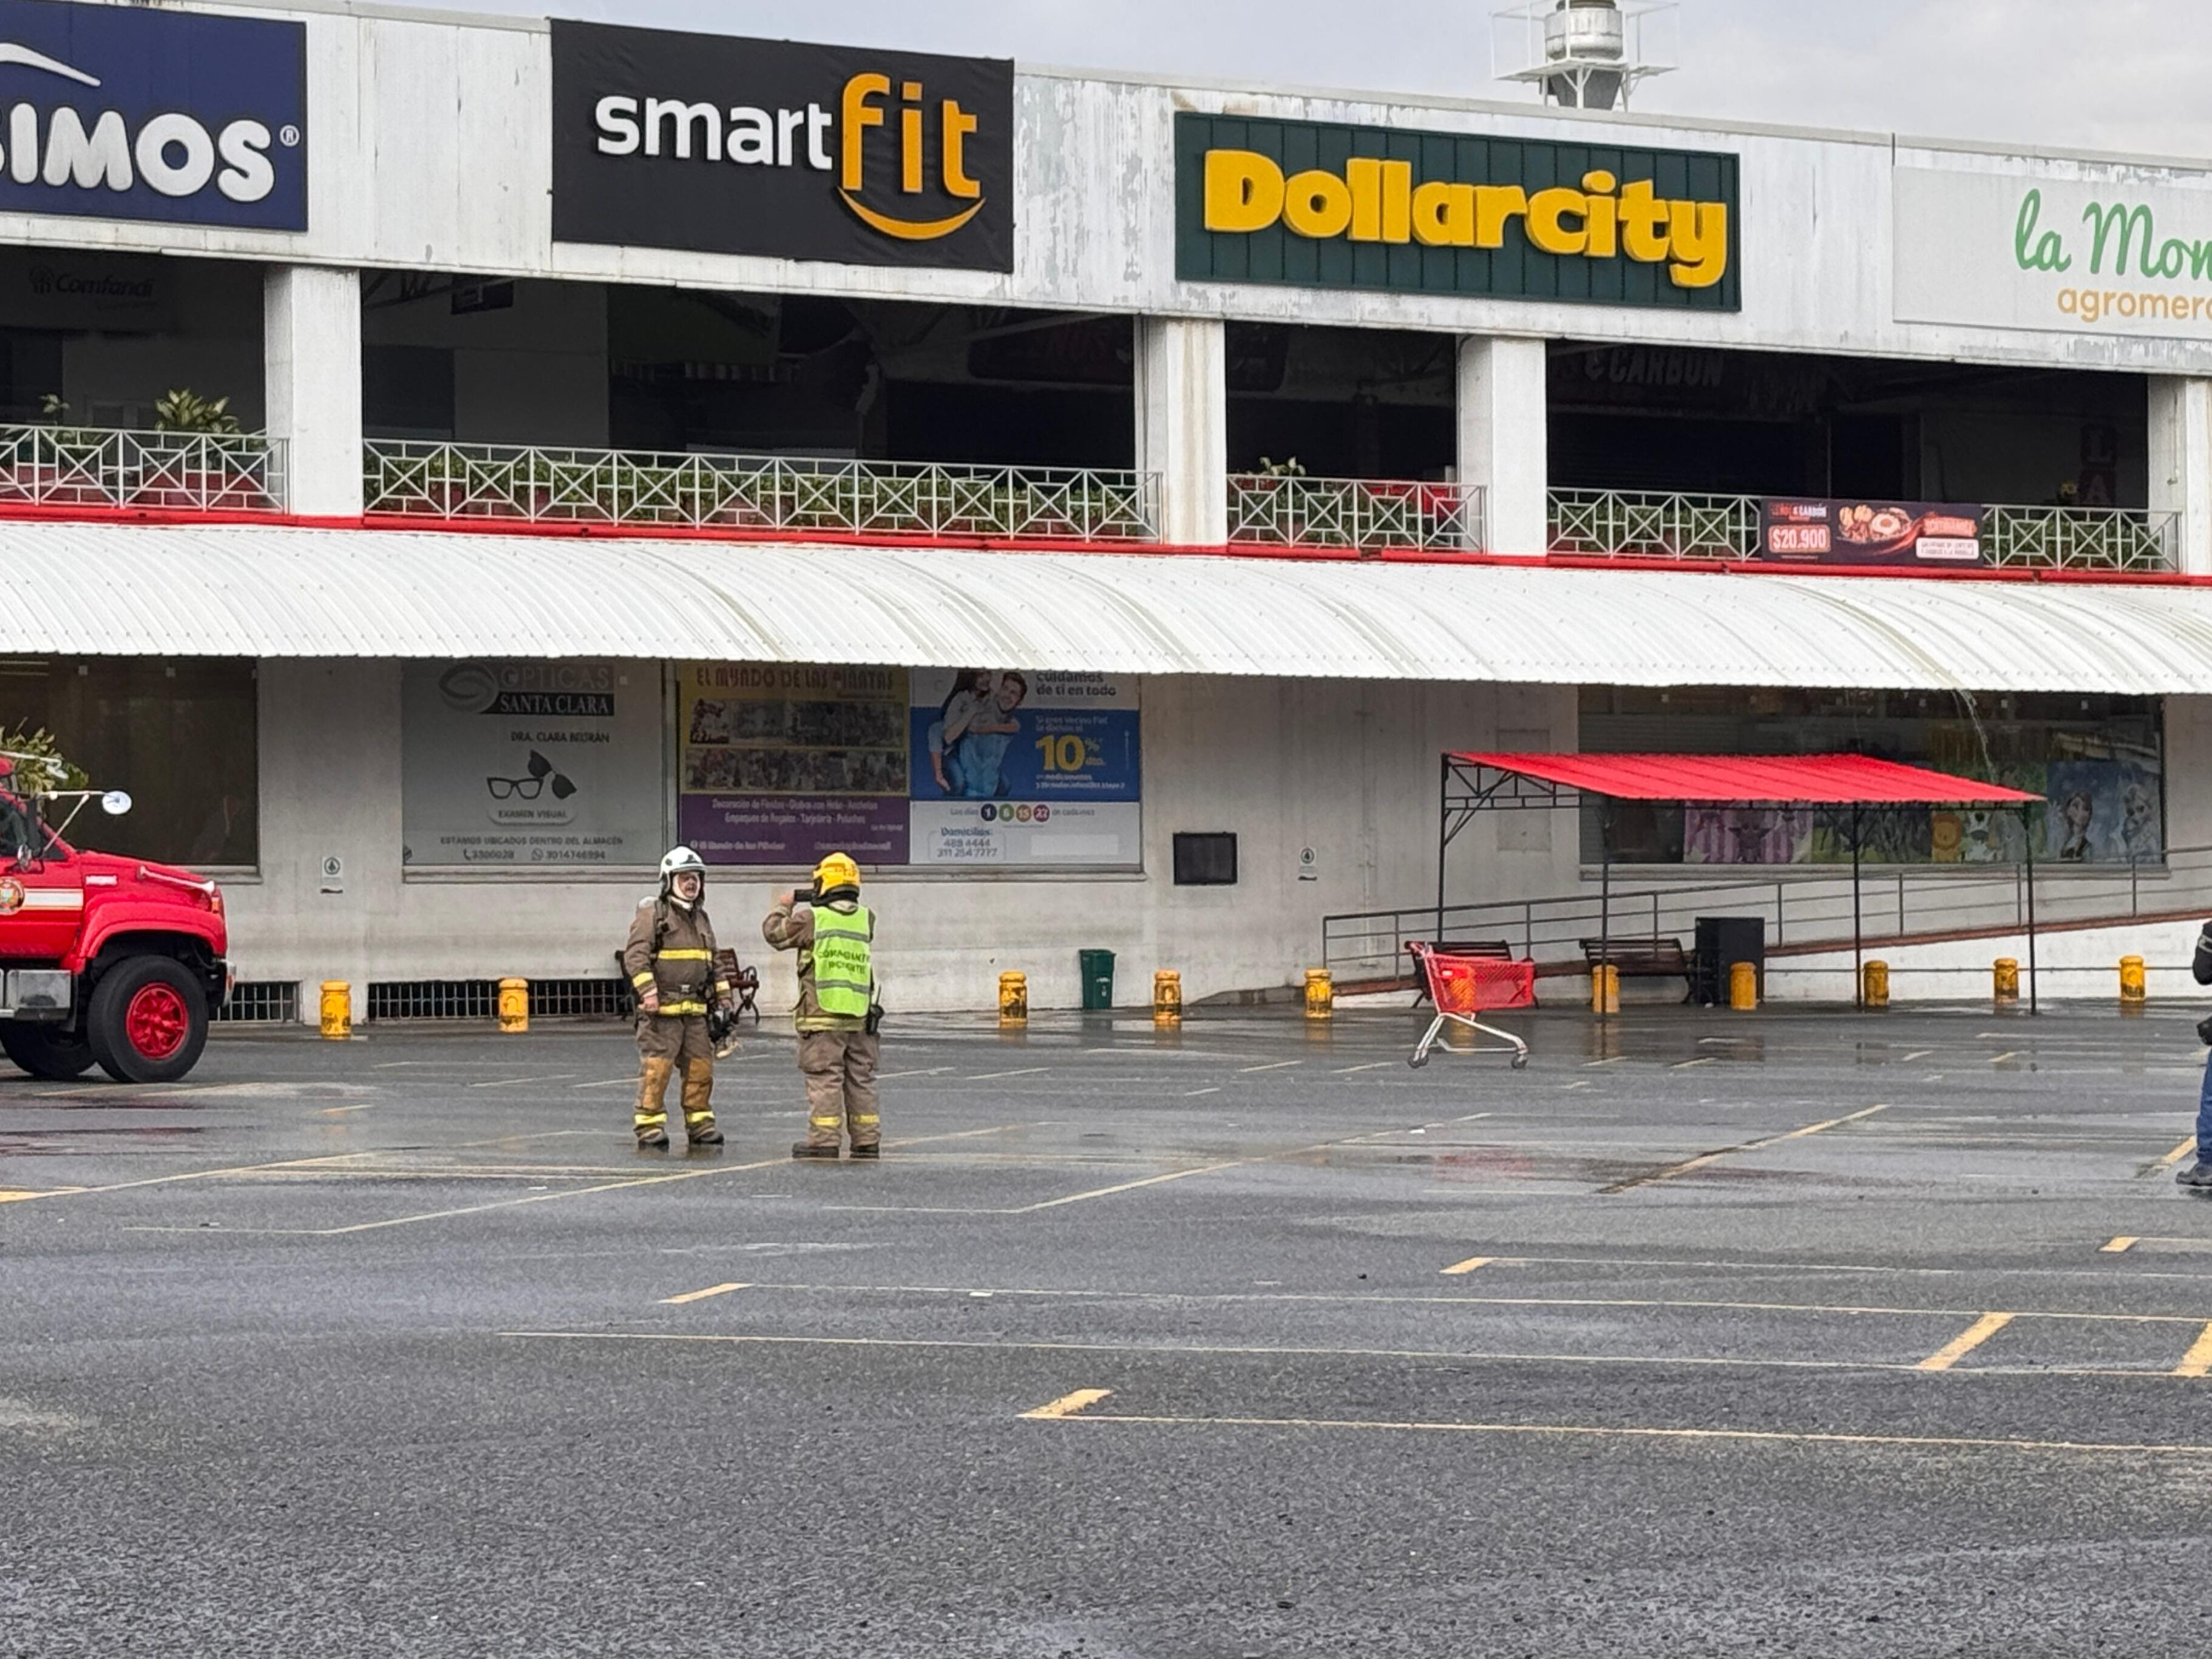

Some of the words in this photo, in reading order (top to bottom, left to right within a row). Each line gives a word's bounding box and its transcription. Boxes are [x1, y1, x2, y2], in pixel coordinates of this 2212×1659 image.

[595, 95, 833, 171] smart
[841, 72, 982, 199] fit
[0, 103, 275, 203] IMOS
[1204, 148, 1728, 288] Dollarcity
[2015, 188, 2072, 271] la
[55, 273, 154, 298] Comfandi
[1773, 528, 1827, 549] $20.900
[696, 667, 711, 687] EL
[781, 668, 801, 688] DE
[805, 669, 827, 690] LAS
[1036, 672, 1104, 683] cuidamos
[1036, 684, 1053, 696] de
[1056, 684, 1065, 696] ti
[1067, 687, 1084, 696] en
[1087, 685, 1117, 696] todo
[500, 694, 552, 713] SANTA
[555, 694, 609, 714] CLARA
[511, 731, 534, 742] DRA.
[537, 731, 567, 742] CLARA
[498, 810, 534, 818] EXAMEN
[1017, 809, 1030, 818] 15
[440, 836, 481, 845] ESTAMOS
[484, 836, 527, 845] UBICADOS
[529, 836, 563, 845] DENTRO
[565, 836, 580, 845] DEL
